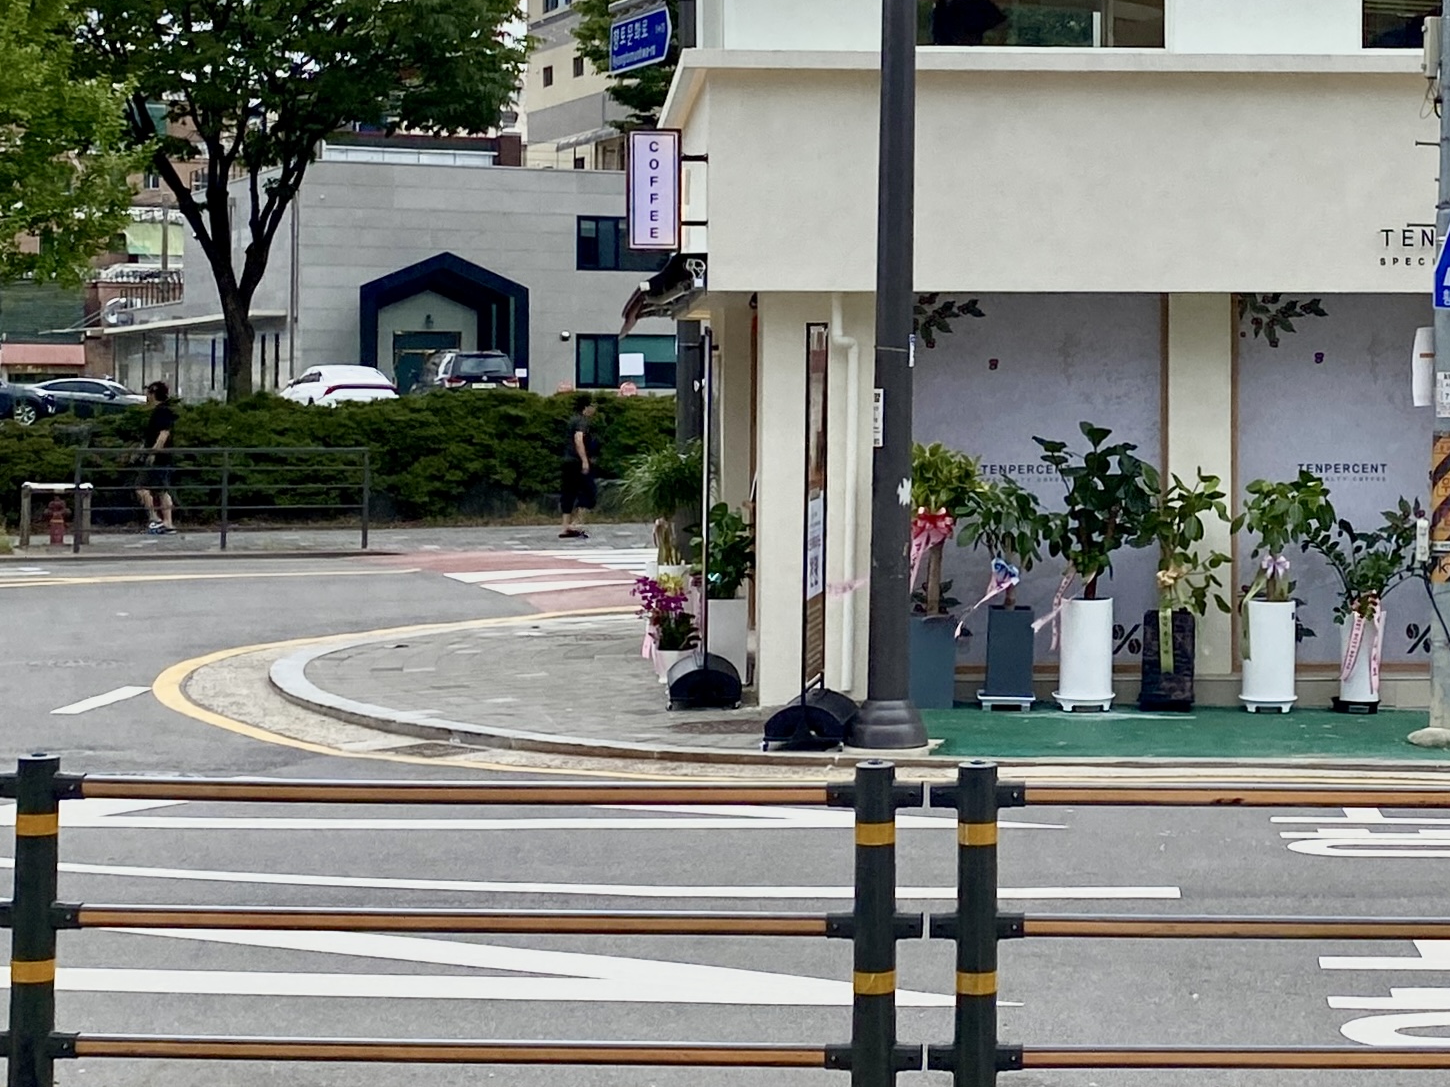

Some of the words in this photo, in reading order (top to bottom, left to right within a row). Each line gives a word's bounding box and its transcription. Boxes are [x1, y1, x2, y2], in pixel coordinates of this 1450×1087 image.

[648, 140, 660, 239] COFFEE
[981, 464, 1071, 475] TENPERCE
[1298, 463, 1387, 474] TENPERCENT
